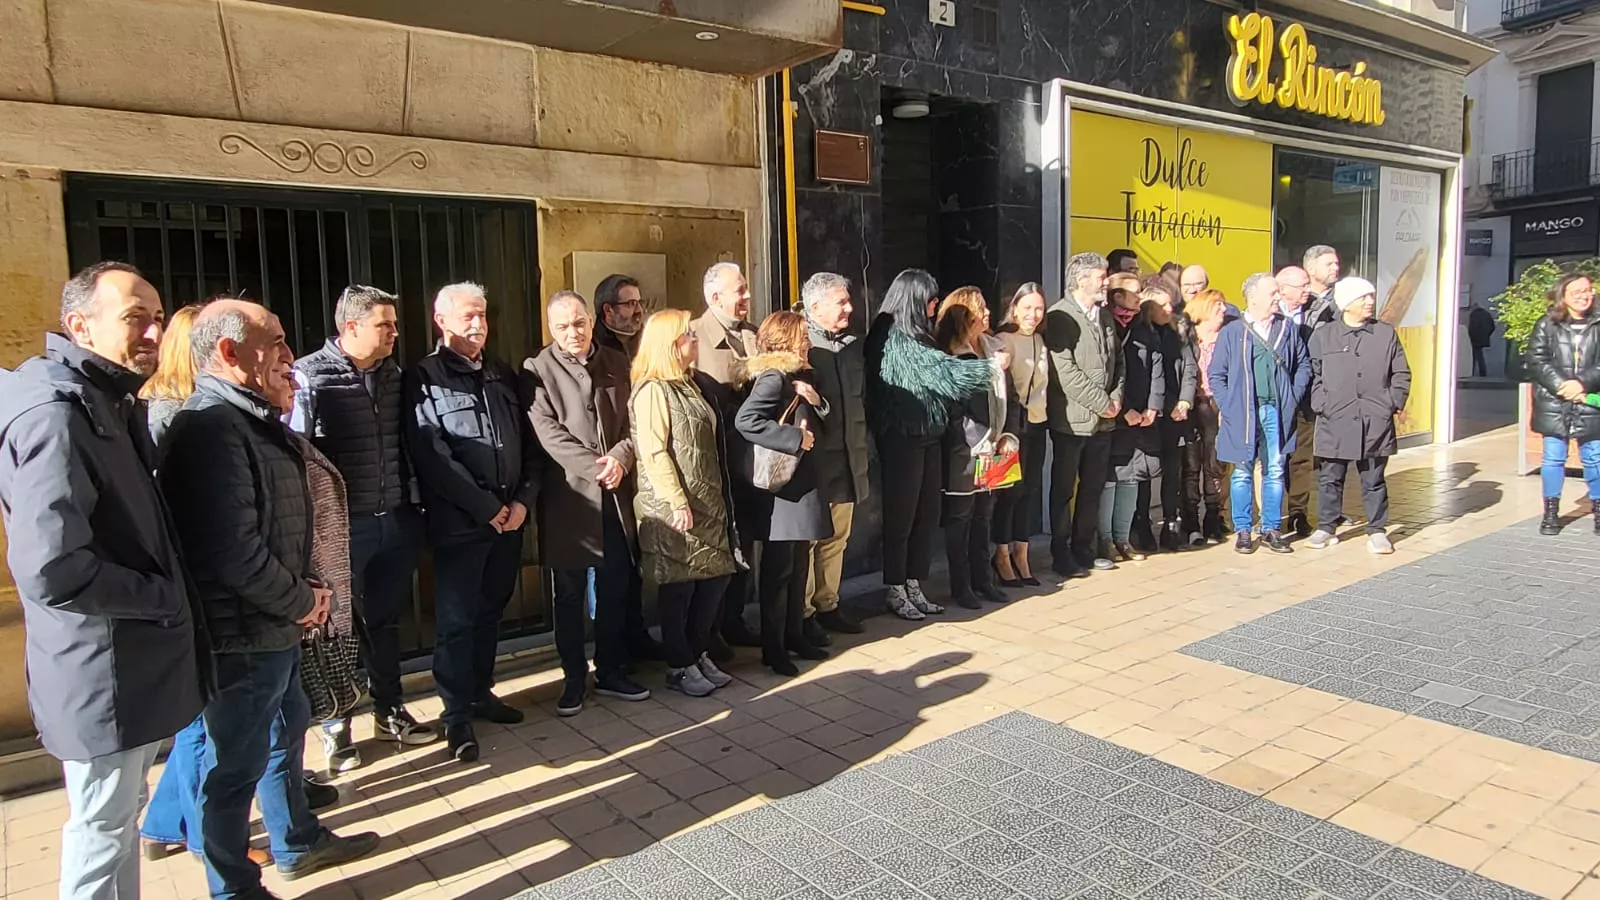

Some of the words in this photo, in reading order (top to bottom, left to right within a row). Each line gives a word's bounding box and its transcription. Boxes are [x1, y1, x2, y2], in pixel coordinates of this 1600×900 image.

[939, 1, 948, 22] 2
[1228, 12, 1275, 104] El
[1277, 23, 1385, 126] Rincón
[1140, 137, 1209, 191] Dulce
[1120, 190, 1224, 247] Tentación
[1525, 216, 1584, 232] MANGO
